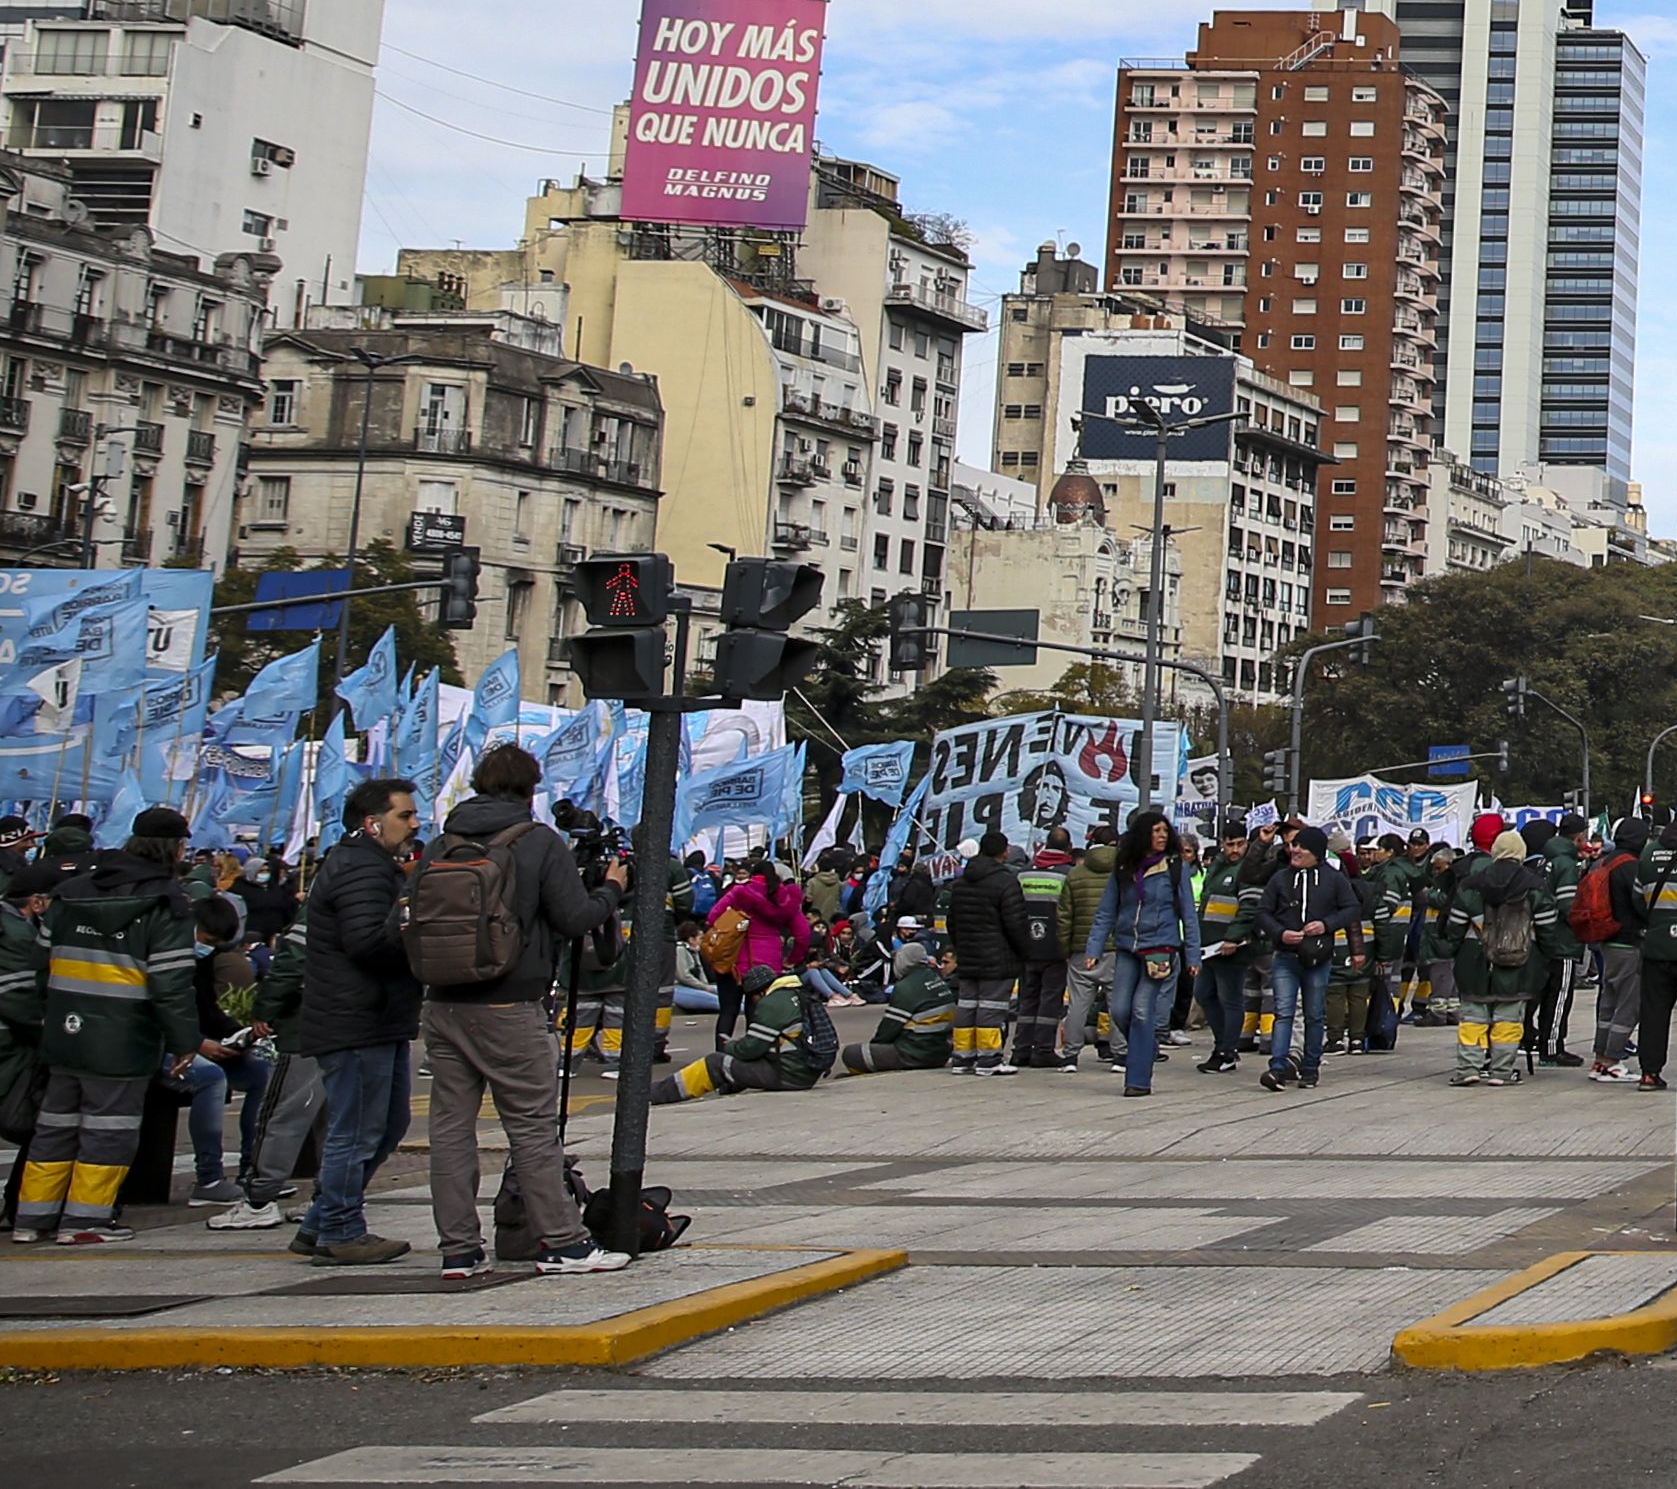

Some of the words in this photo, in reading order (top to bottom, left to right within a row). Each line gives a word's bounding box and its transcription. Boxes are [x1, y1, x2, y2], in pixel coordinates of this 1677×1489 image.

[652, 17, 735, 56] HOY
[737, 19, 818, 63] MÁS
[642, 60, 809, 114] UNIDOS
[635, 112, 697, 145] QUE
[702, 116, 804, 153] NUNCA
[662, 184, 769, 202] MAGNUS
[665, 167, 772, 187] DELFINO
[411, 514, 424, 546] VENDE
